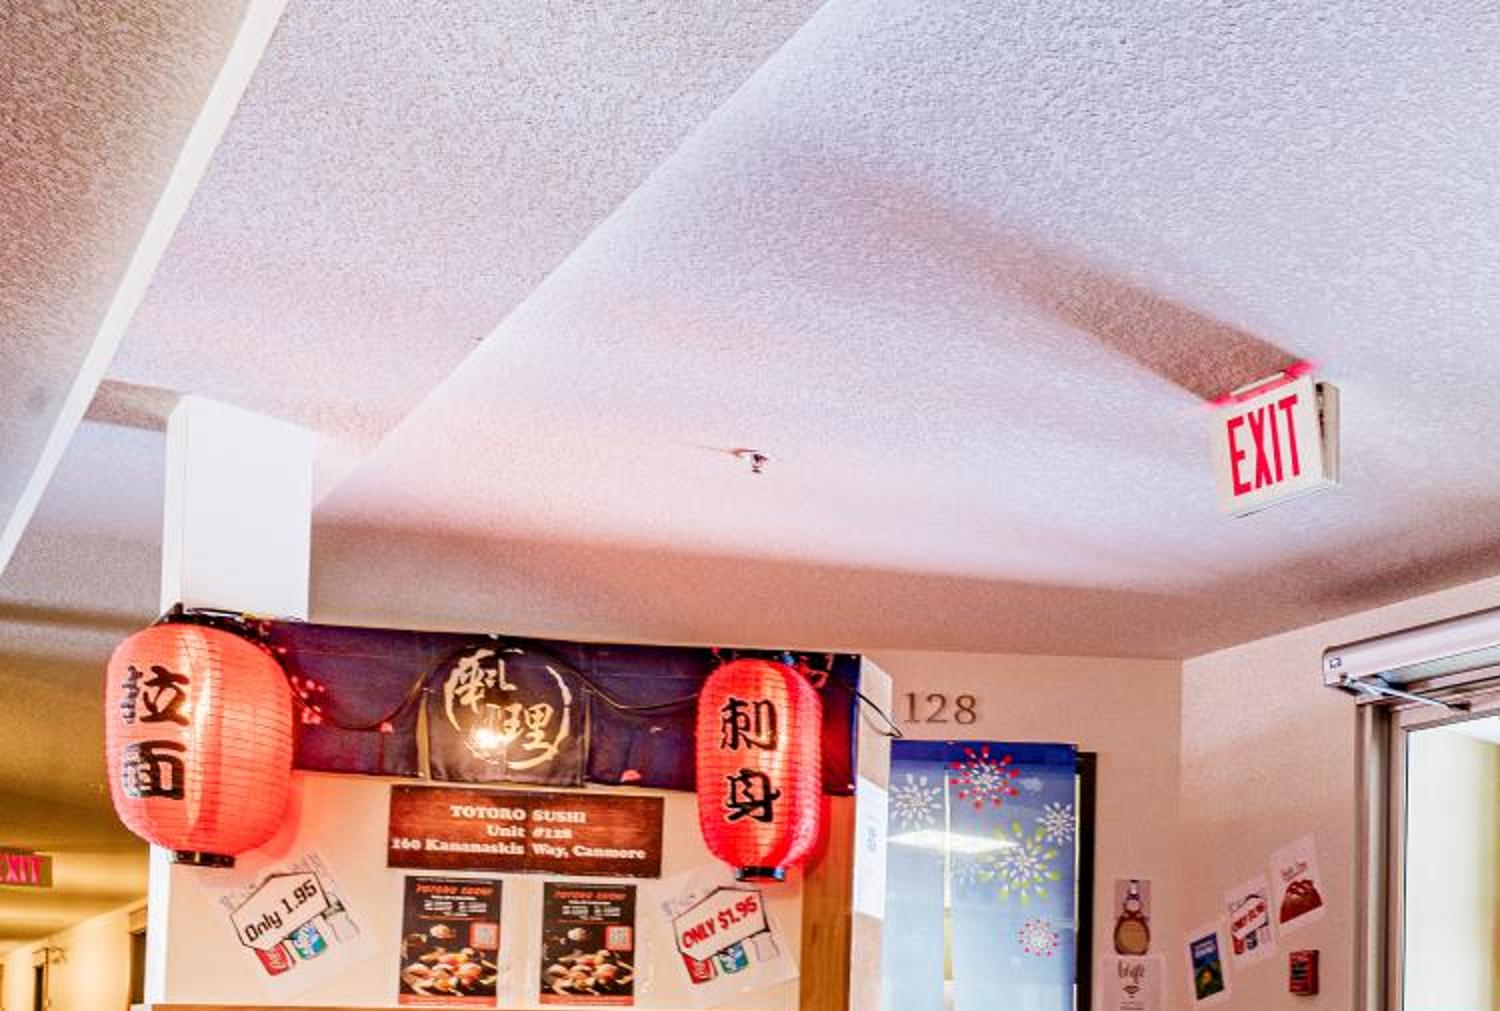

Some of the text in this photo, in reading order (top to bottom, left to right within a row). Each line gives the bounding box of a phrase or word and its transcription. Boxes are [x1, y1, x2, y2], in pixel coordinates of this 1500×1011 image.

[1227, 394, 1300, 496] EXIT
[904, 692, 977, 724] 128
[720, 698, 782, 824] 刺身
[450, 805, 587, 823] TOTORO SUSHI
[486, 825, 573, 839] Unit #128
[391, 838, 647, 860] 160 Kananaskis Way, Canmore
[0, 855, 43, 882] XIT
[244, 878, 318, 943] Only 1.95
[681, 917, 716, 950] ONLY
